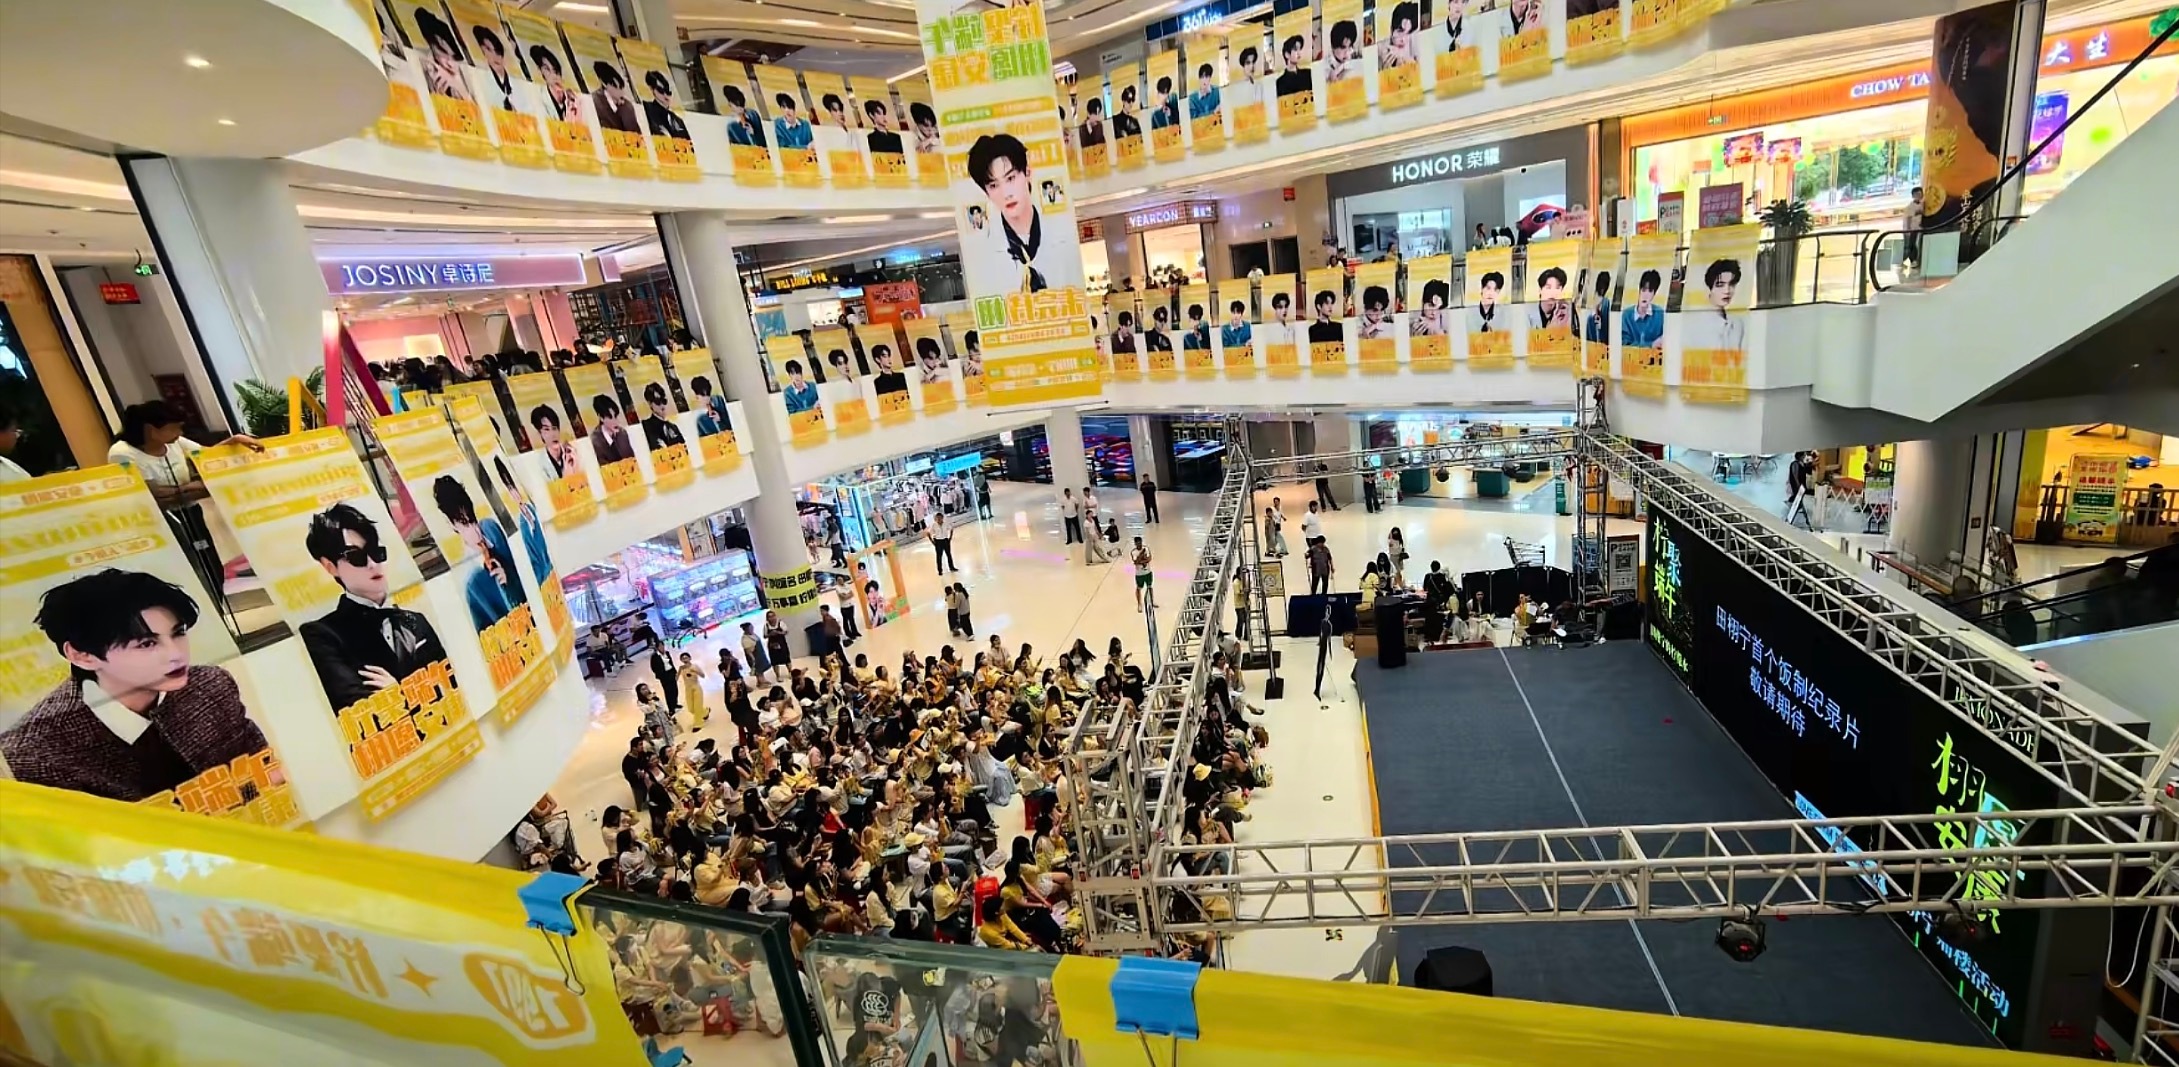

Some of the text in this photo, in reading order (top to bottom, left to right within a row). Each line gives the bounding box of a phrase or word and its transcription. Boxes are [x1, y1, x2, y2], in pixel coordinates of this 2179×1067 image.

[1851, 78, 1904, 97] CHOW
[1391, 154, 1463, 183] HONOR
[343, 264, 496, 287] JOSINY 卓诗尼
[337, 657, 461, 744] 柠聚端午
[1716, 604, 1861, 750] 田栩宁首个饭制纪录片
[1750, 666, 1806, 738] 敬请期待
